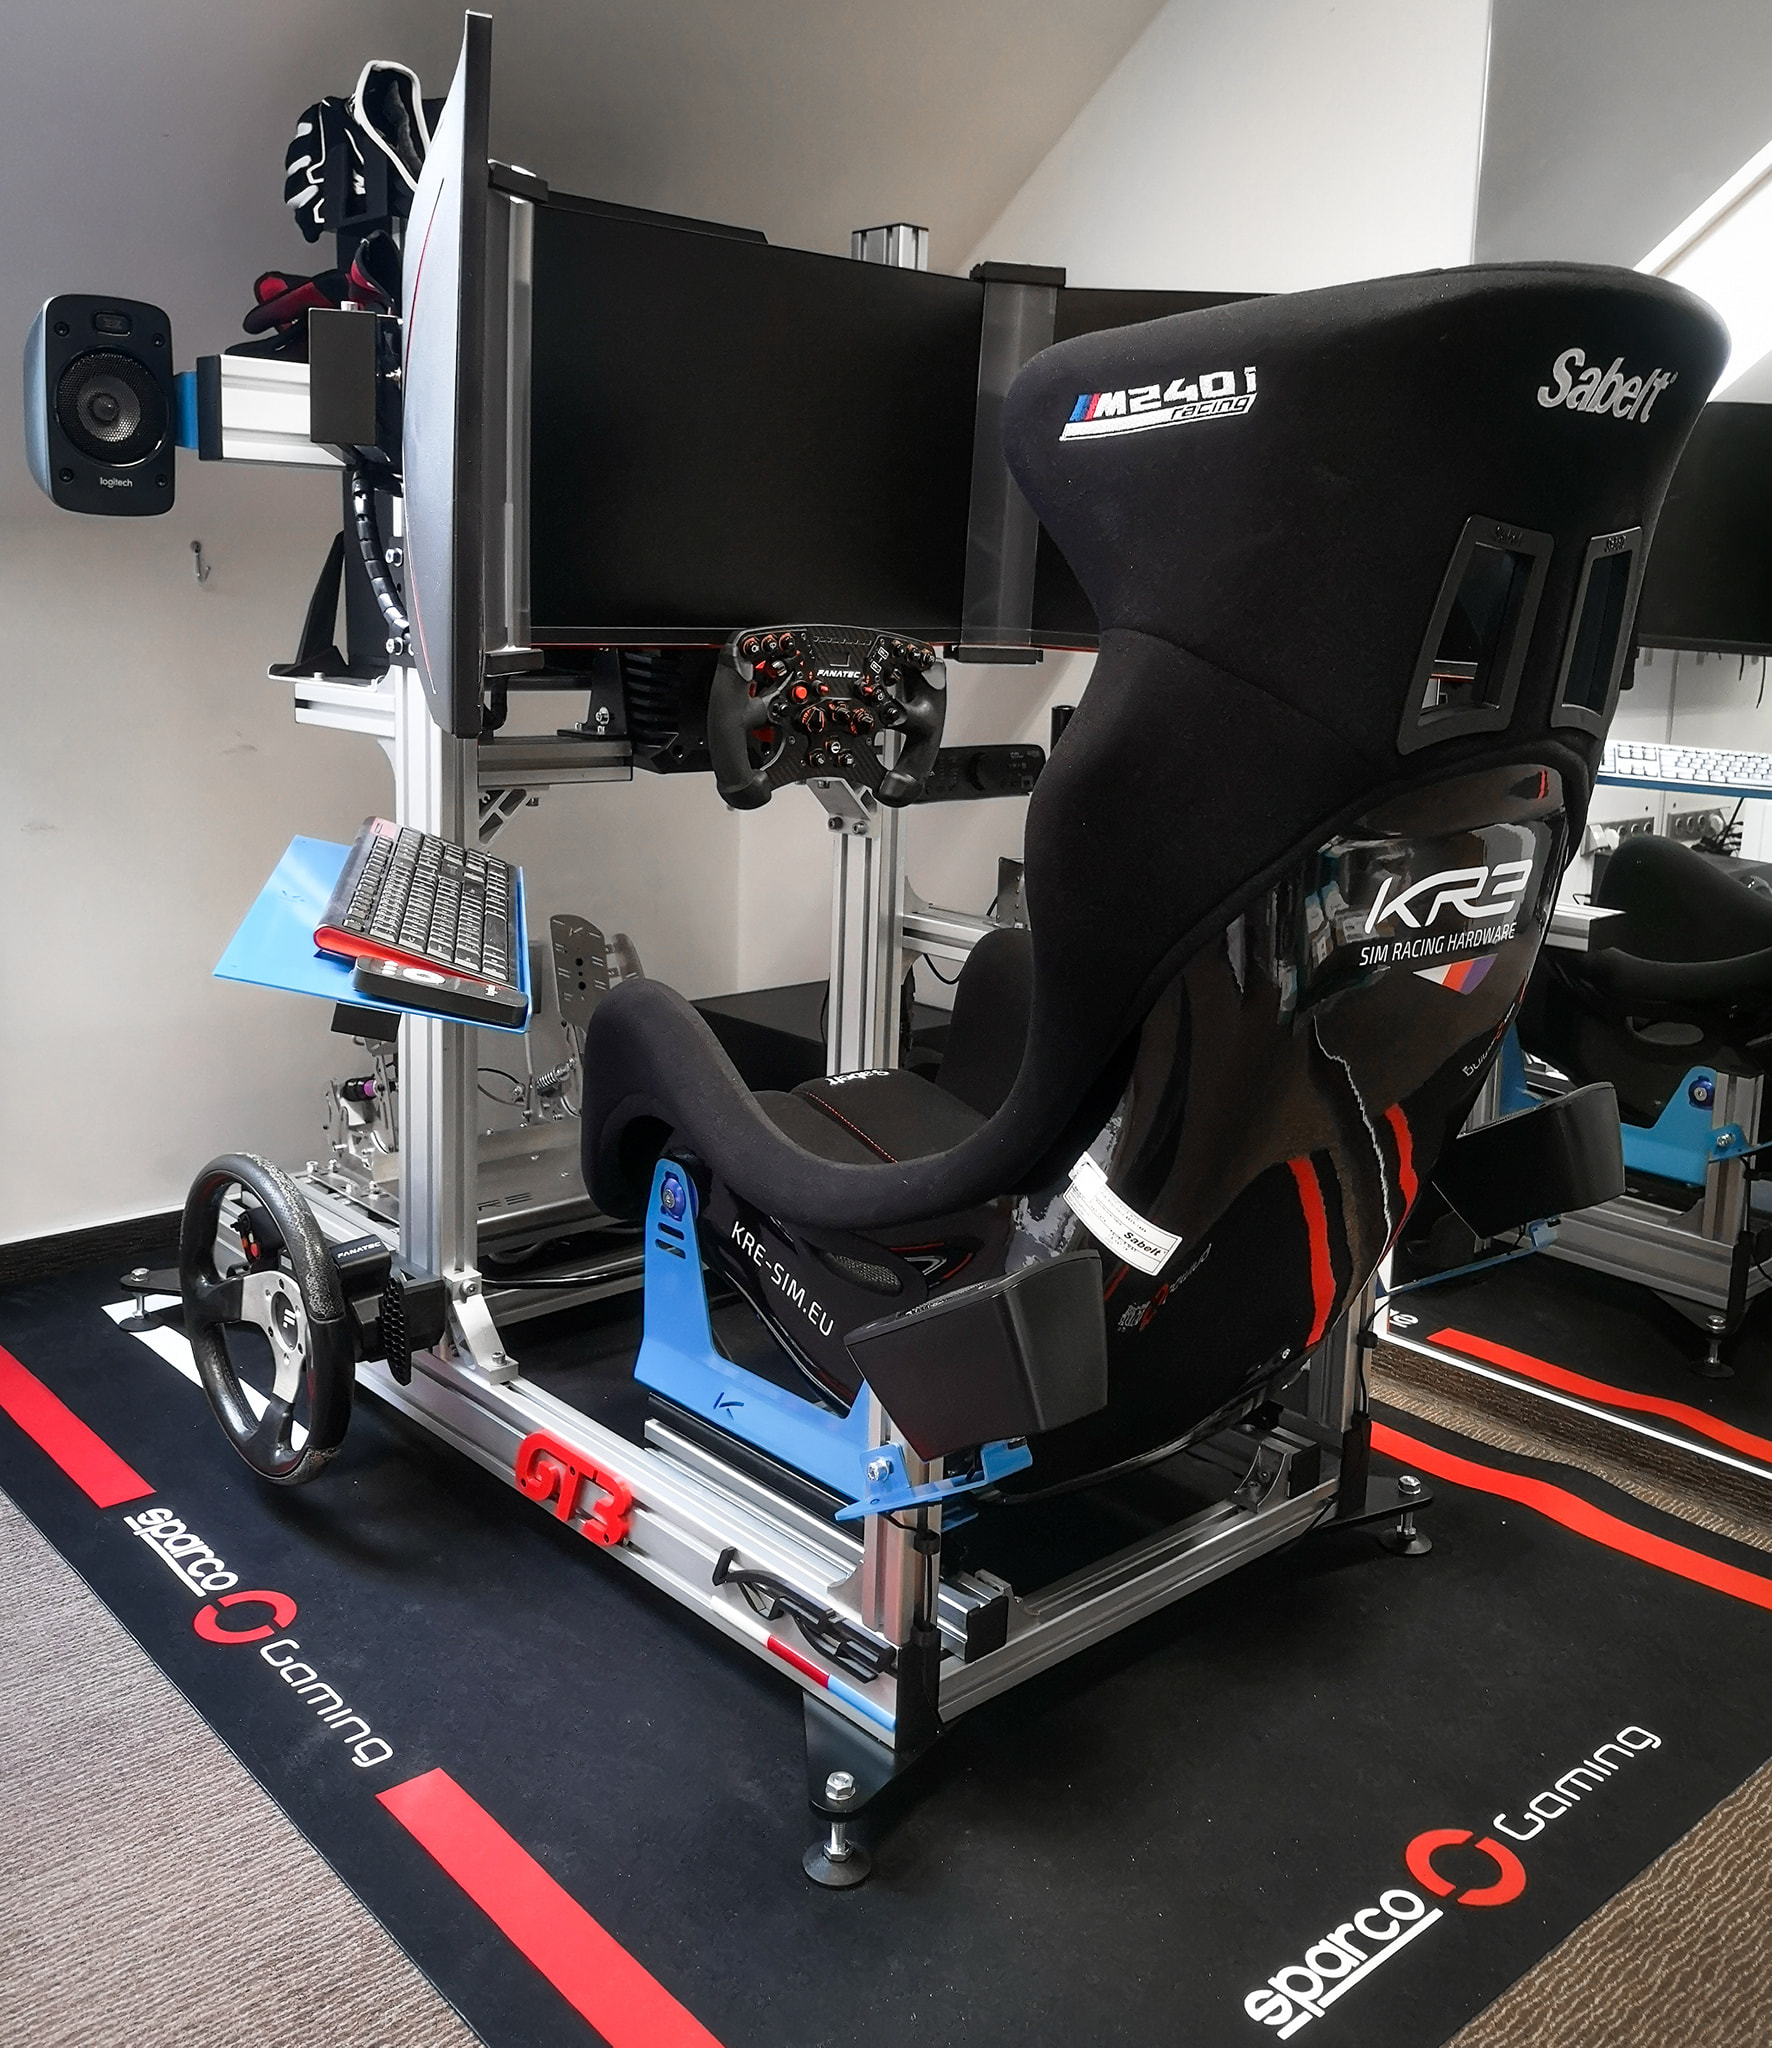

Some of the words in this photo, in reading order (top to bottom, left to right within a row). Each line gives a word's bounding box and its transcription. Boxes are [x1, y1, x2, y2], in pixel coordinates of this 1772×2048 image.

[1537, 347, 1673, 423] Sabelt
[1170, 396, 1250, 420] racing
[100, 477, 132, 488] logitech
[816, 669, 861, 679] FANATEC
[1359, 945, 1389, 966] SIM
[1391, 936, 1445, 961] RACING
[1446, 922, 1518, 952] HARDWARE
[337, 1241, 381, 1259] FANATEC
[1123, 1231, 1161, 1257] Sabelt
[731, 1221, 834, 1336] KRE-SIM.EU
[515, 1429, 632, 1546] GT3
[123, 1507, 239, 1598] sparco
[259, 1638, 394, 1768] Gaming
[1243, 1889, 1444, 2040] sparco
[1493, 1725, 1662, 1841] Gaming
